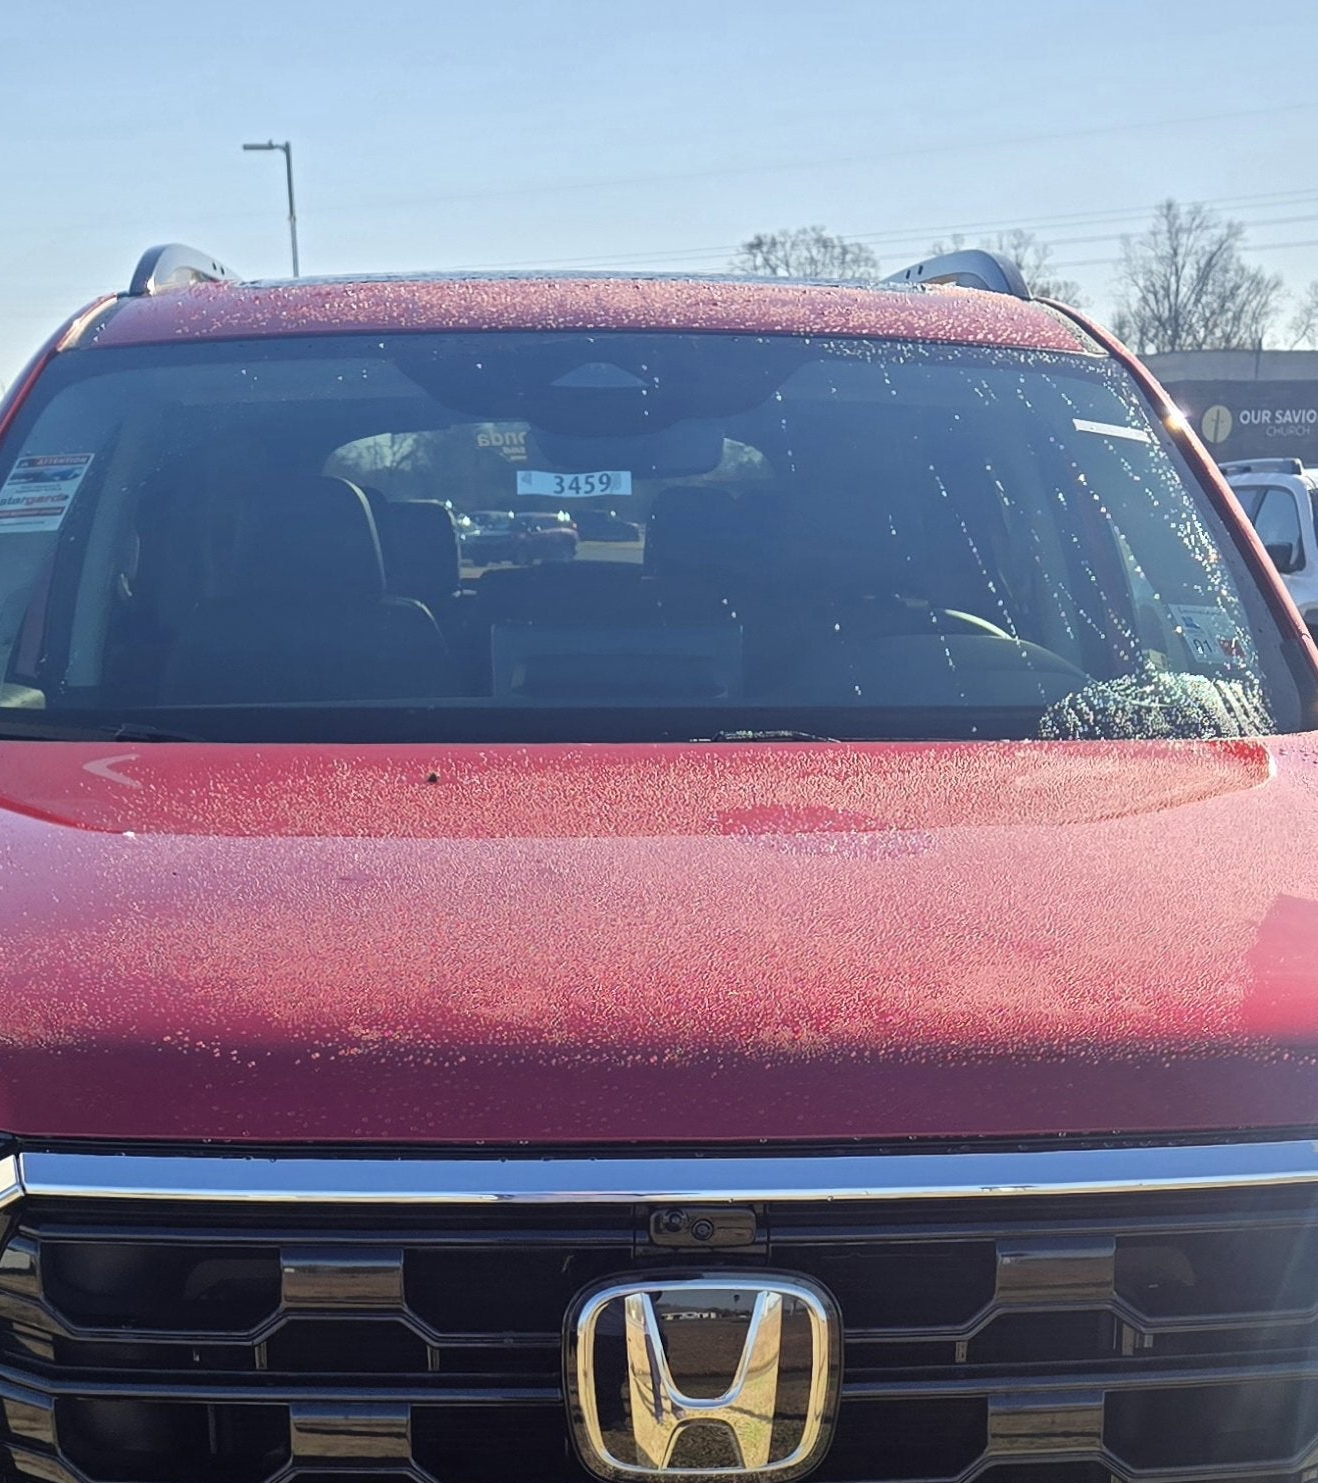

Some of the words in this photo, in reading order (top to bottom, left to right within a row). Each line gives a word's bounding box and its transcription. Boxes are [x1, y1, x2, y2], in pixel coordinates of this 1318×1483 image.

[1239, 410, 1271, 424] OUR
[1265, 426, 1310, 437] CHURCH
[553, 473, 611, 495] 3459
